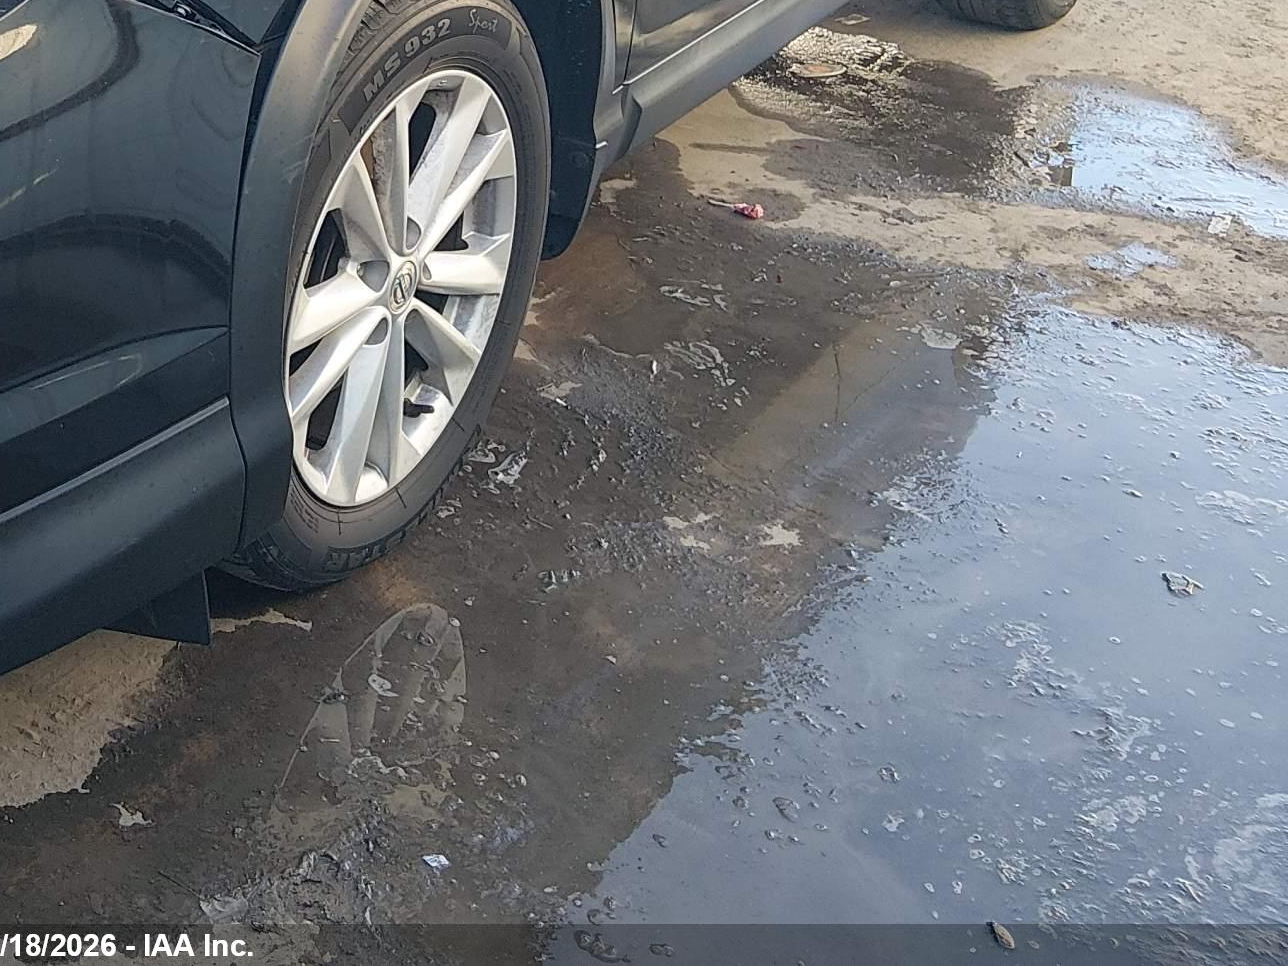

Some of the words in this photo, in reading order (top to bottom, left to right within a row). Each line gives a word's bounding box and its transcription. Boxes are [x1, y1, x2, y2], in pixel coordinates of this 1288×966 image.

[363, 53, 401, 101] MS
[404, 19, 451, 57] 932
[468, 8, 499, 34] Sport
